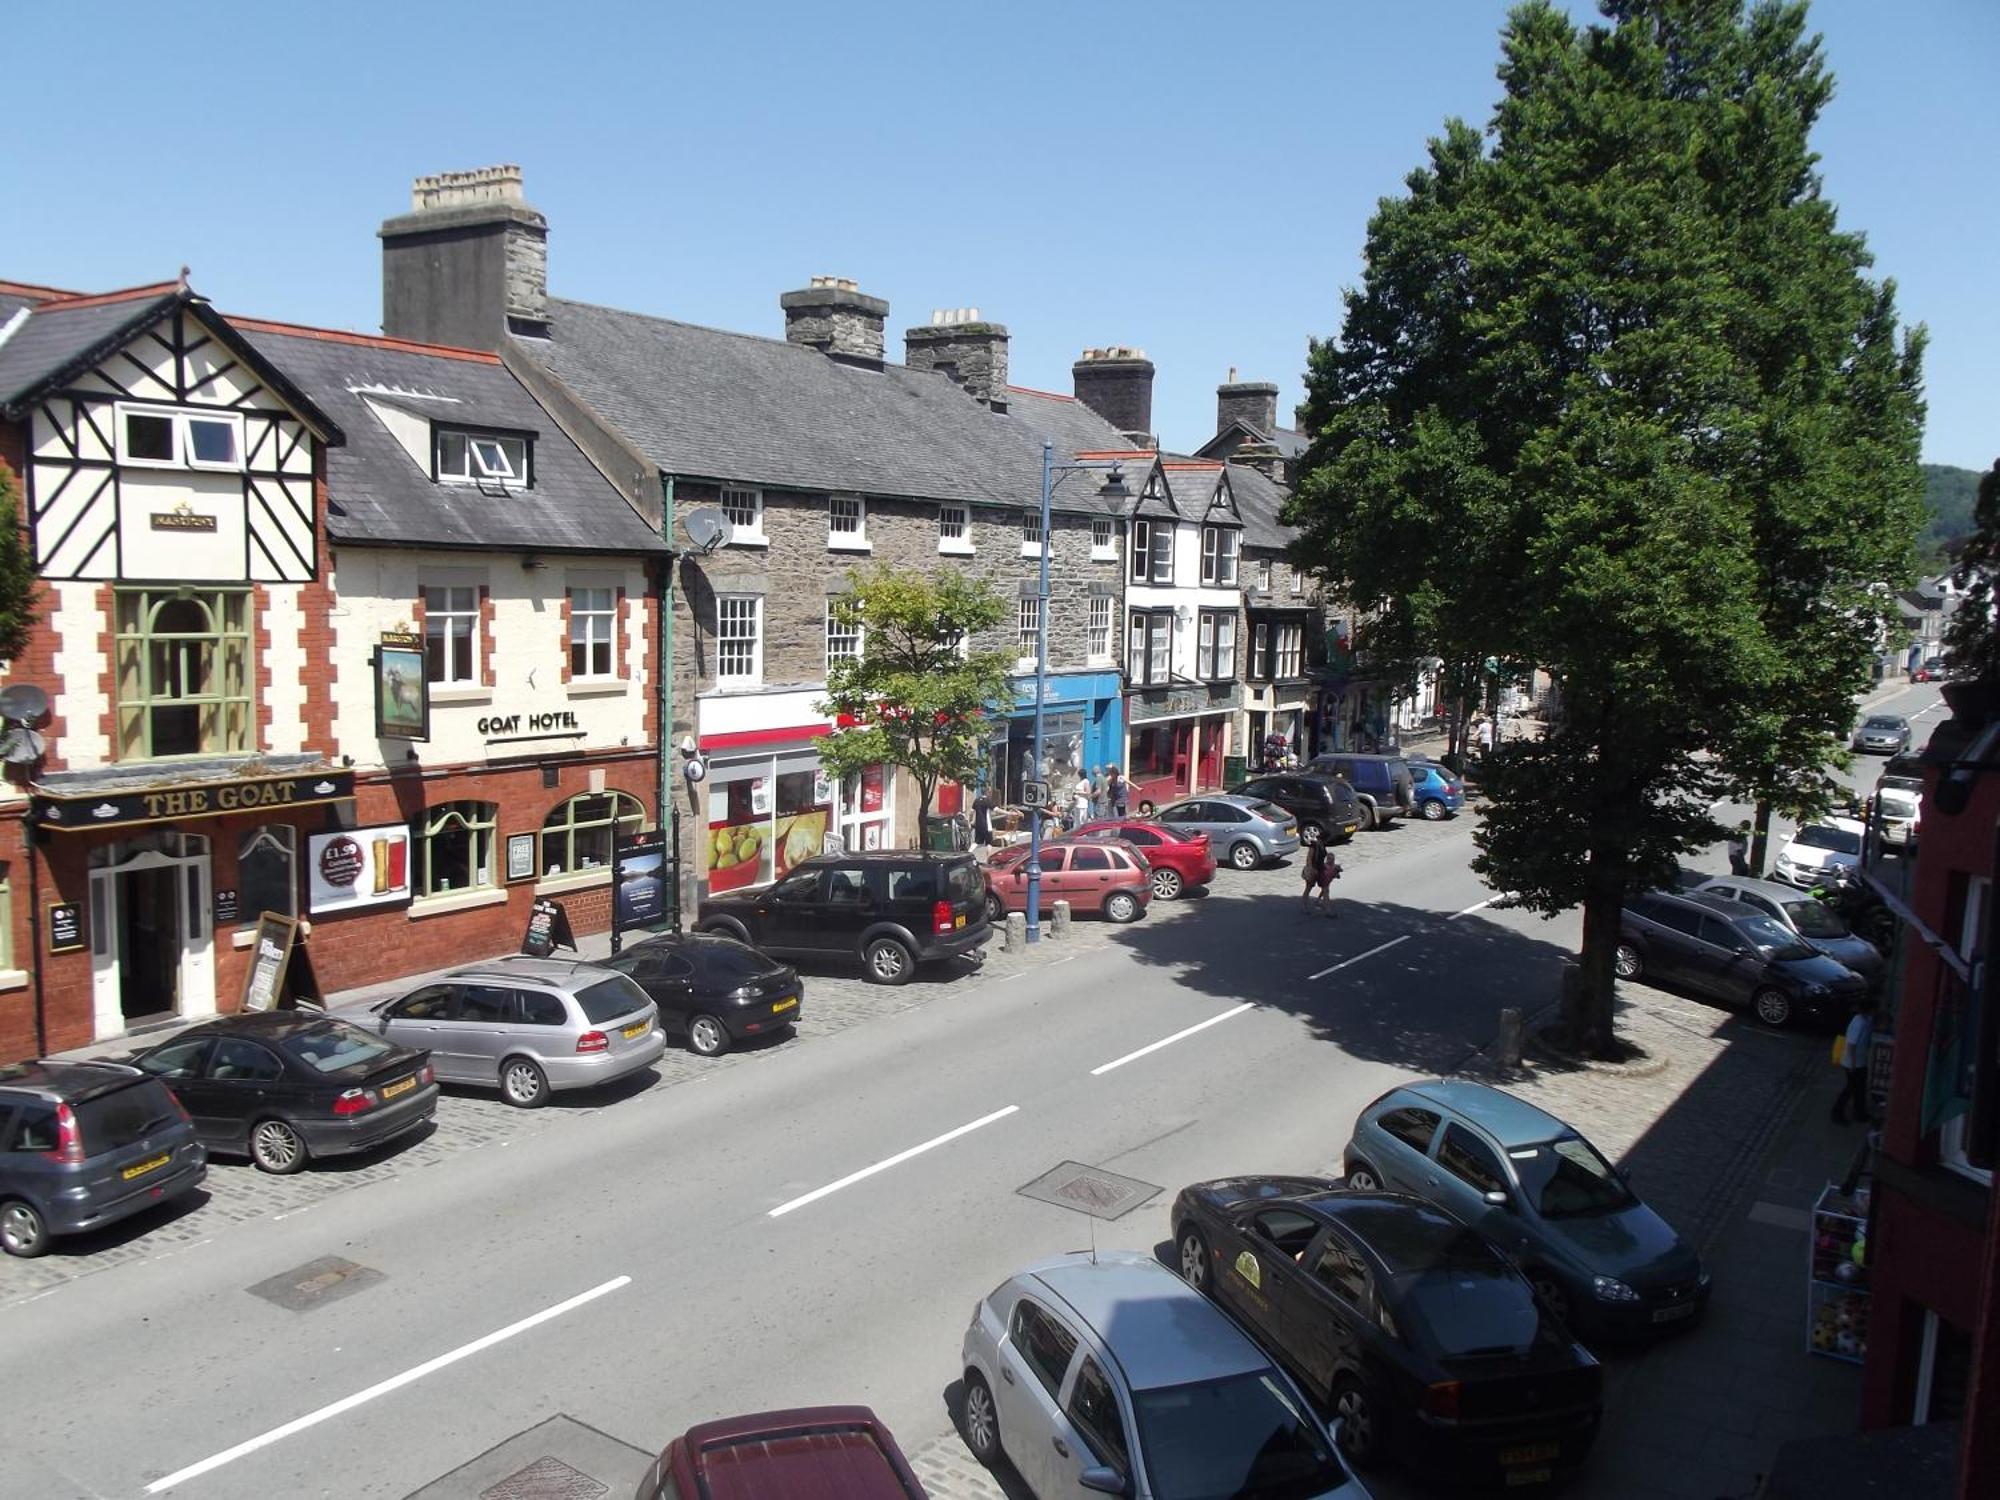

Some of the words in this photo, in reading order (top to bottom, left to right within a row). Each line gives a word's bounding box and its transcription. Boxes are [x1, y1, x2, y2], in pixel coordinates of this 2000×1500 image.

[477, 715, 521, 735] GOAT
[529, 711, 578, 731] HOTEL
[143, 789, 209, 817] THE
[217, 780, 296, 808] GOAT
[325, 843, 357, 860] £1.99
